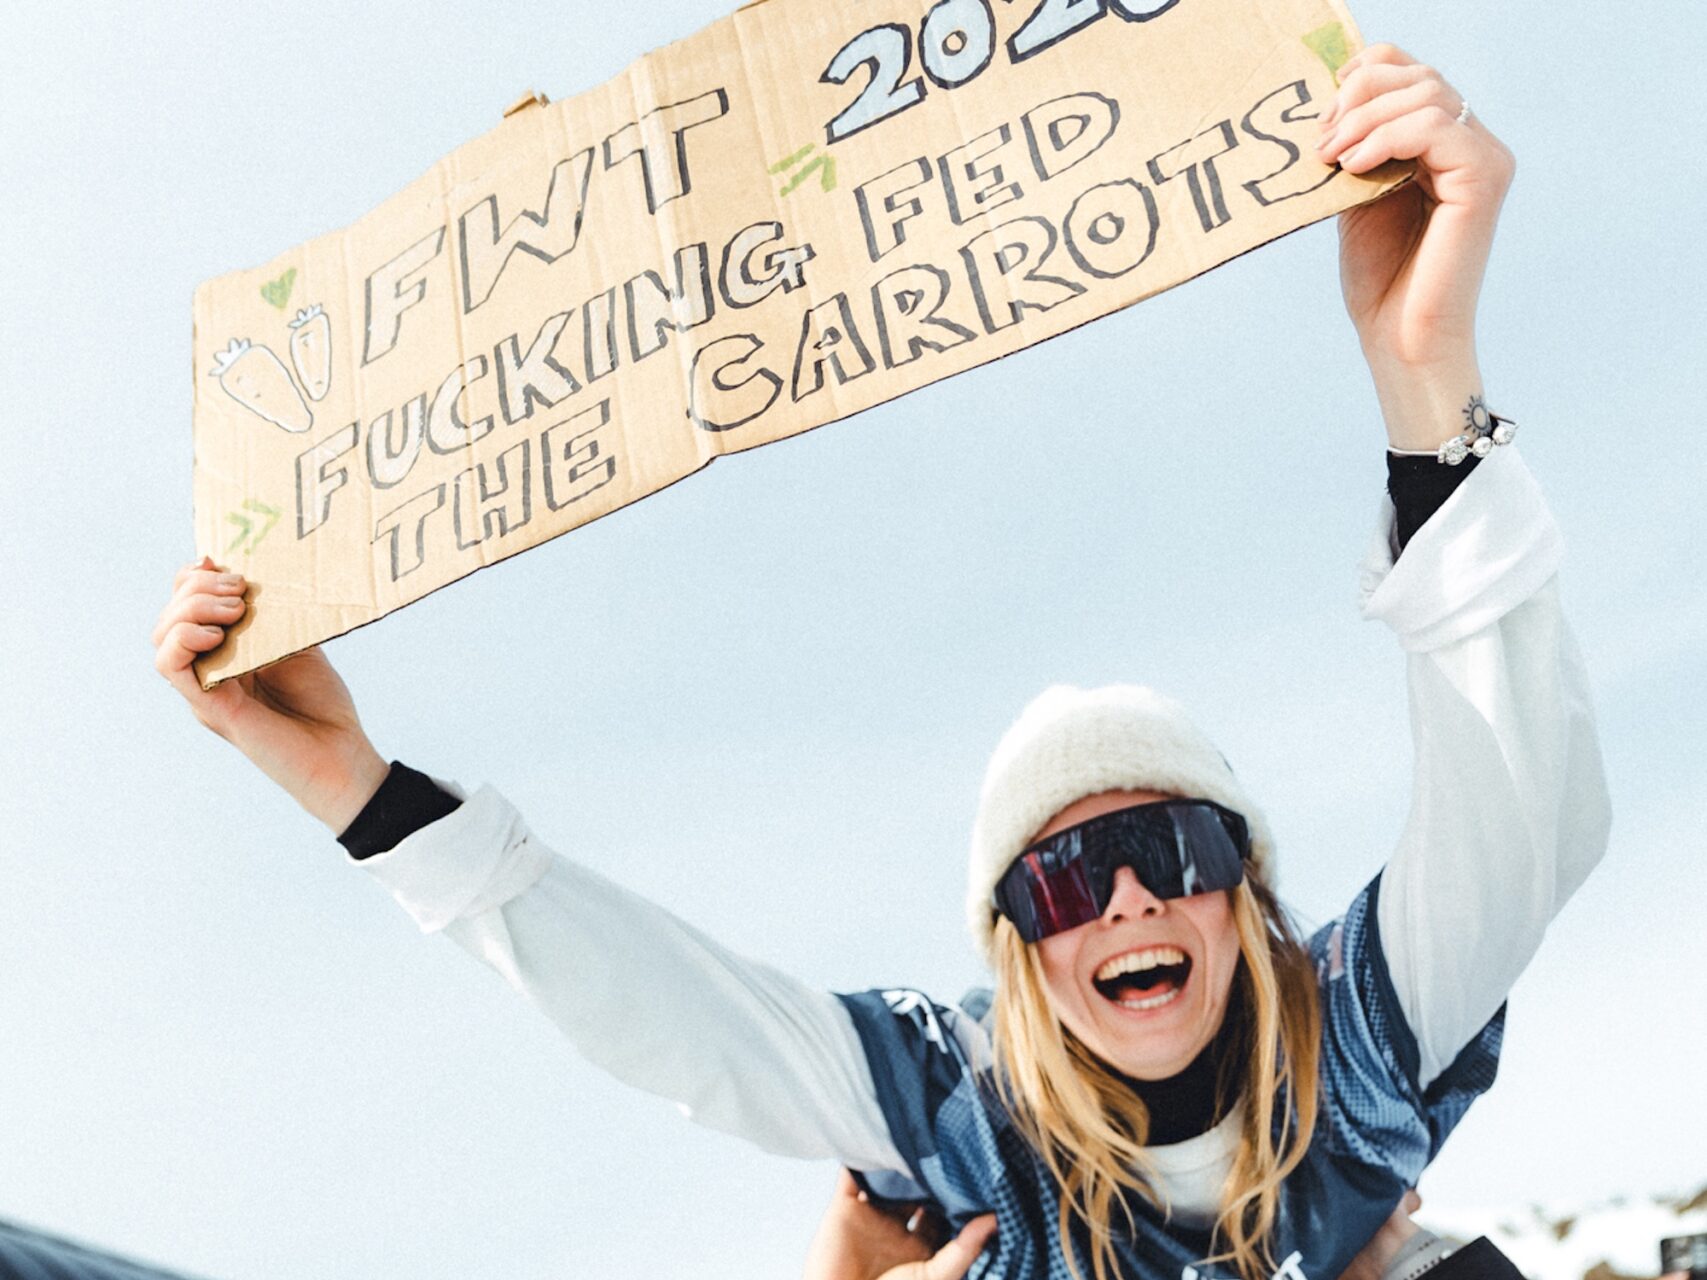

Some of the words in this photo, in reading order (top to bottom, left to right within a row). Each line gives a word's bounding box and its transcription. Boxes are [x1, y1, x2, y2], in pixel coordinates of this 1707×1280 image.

[293, 220, 815, 540] FUCKING
[853, 92, 1120, 262] FED
[361, 87, 728, 369] FWT
[818, 0, 1181, 145] 202
[371, 399, 617, 582] THE
[687, 79, 1340, 431] CARROTS
